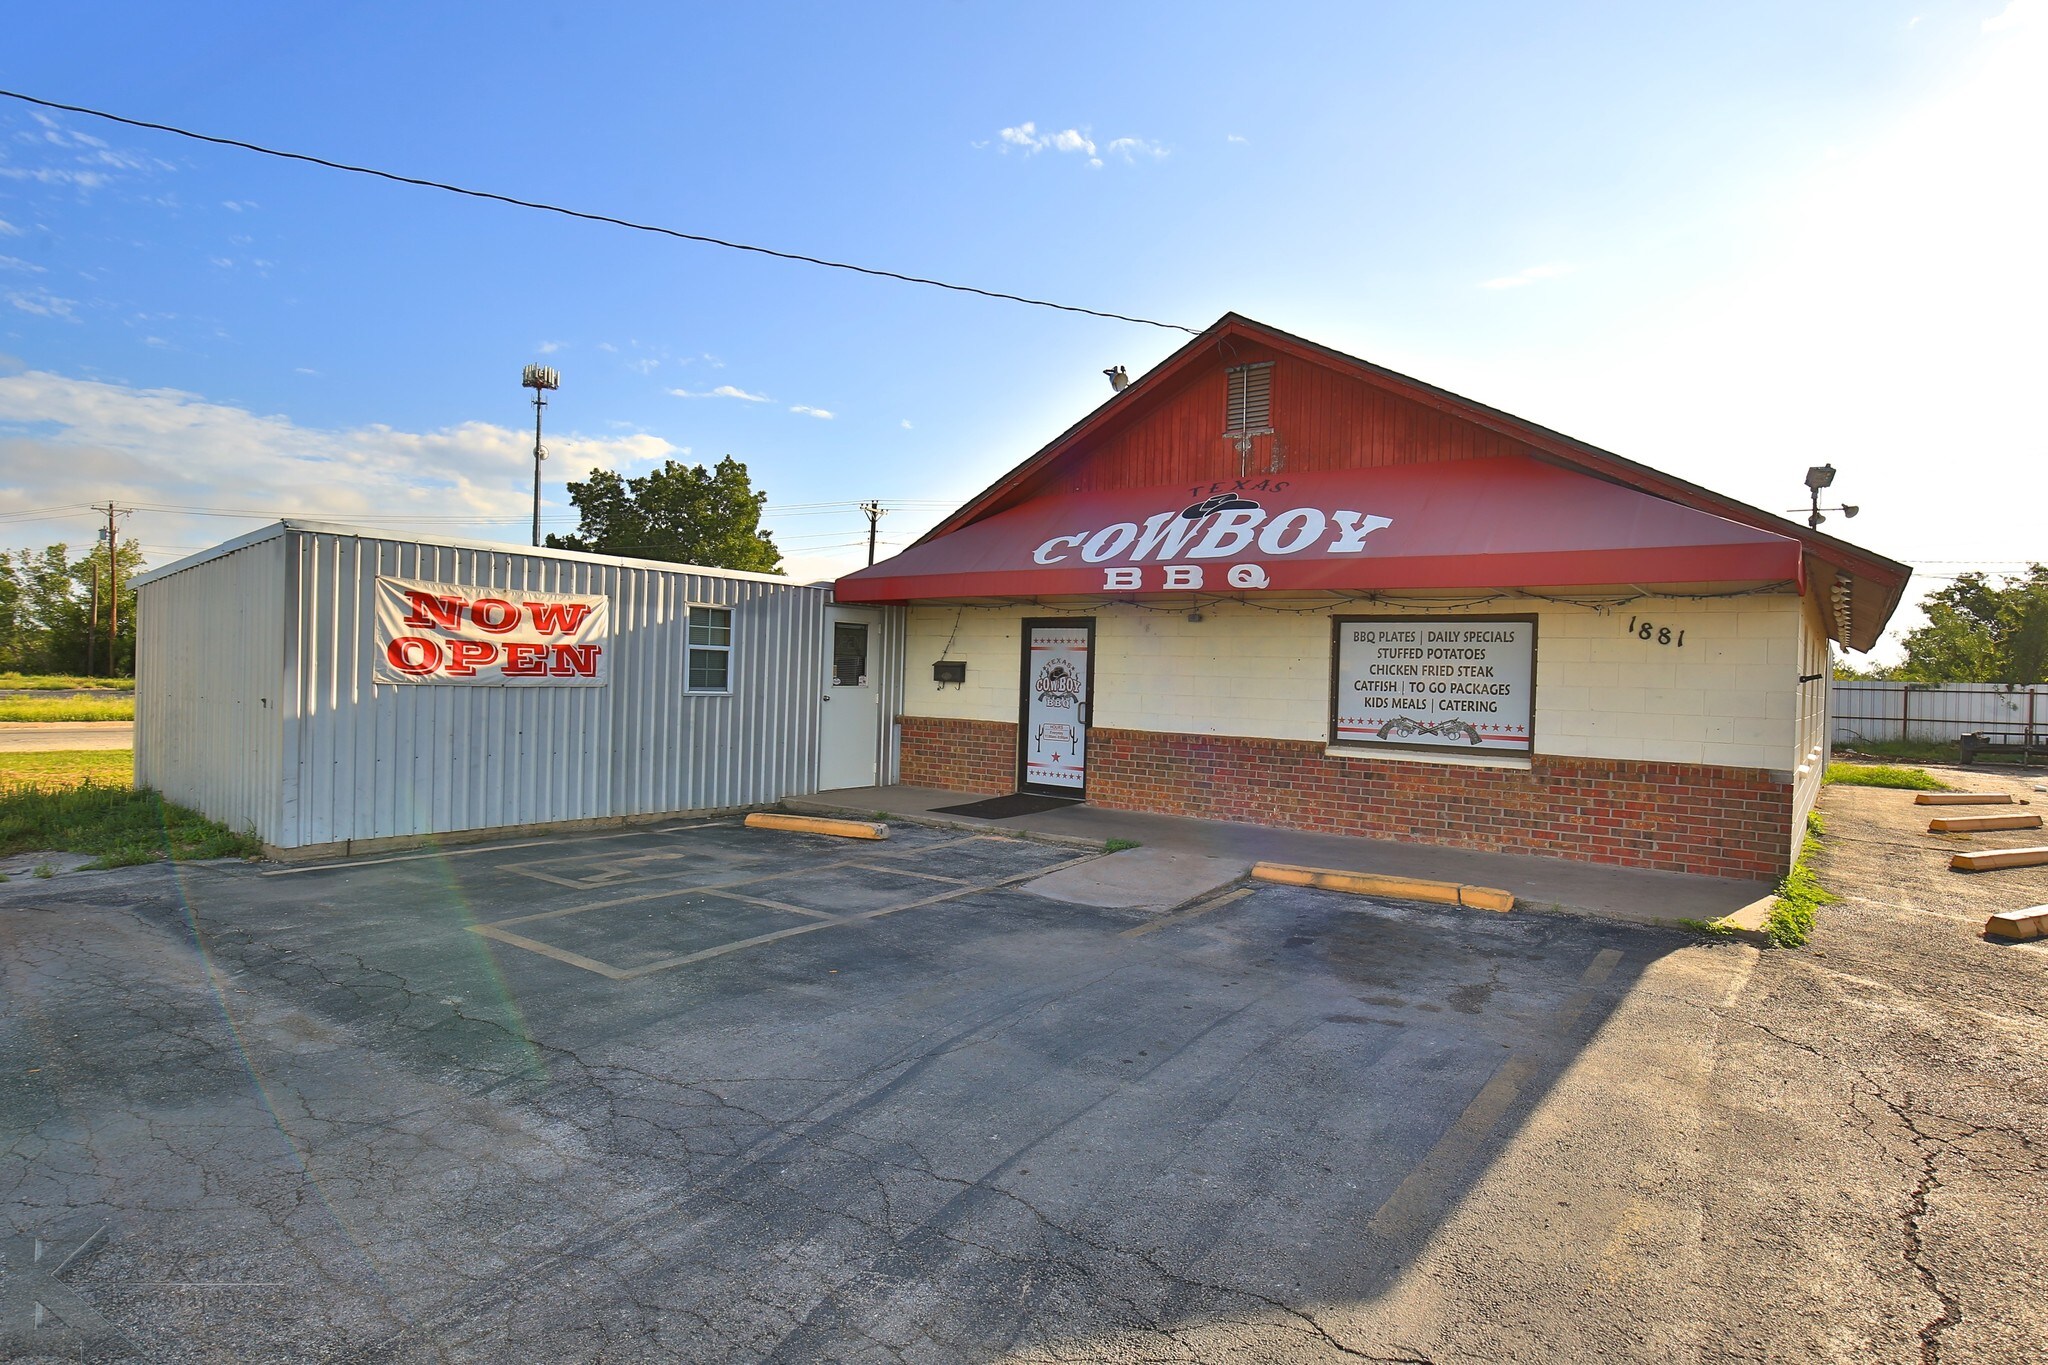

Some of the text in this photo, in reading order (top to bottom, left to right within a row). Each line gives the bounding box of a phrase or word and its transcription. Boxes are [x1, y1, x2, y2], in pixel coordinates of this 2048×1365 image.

[1189, 479, 1292, 498] TEXAS
[1032, 507, 1393, 565] COWBOY
[1103, 563, 1270, 591] BBQ
[403, 591, 592, 636] NOW
[1353, 631, 1515, 644] BBQ PLATES DAILY SPECIALS
[1628, 615, 1685, 647] 1881
[387, 636, 602, 677] OPEN
[1377, 648, 1486, 660] STUFFED POTATOES
[1046, 658, 1072, 669] TEXAS
[1369, 664, 1494, 678] CHICKEN FRIED STEAK
[1035, 677, 1081, 693] COWBOY
[1354, 680, 1510, 696] CATFISH TO GO PACKAGES
[1046, 699, 1070, 709] BBQ
[1364, 697, 1498, 712] KIDS MEALS CATERING
